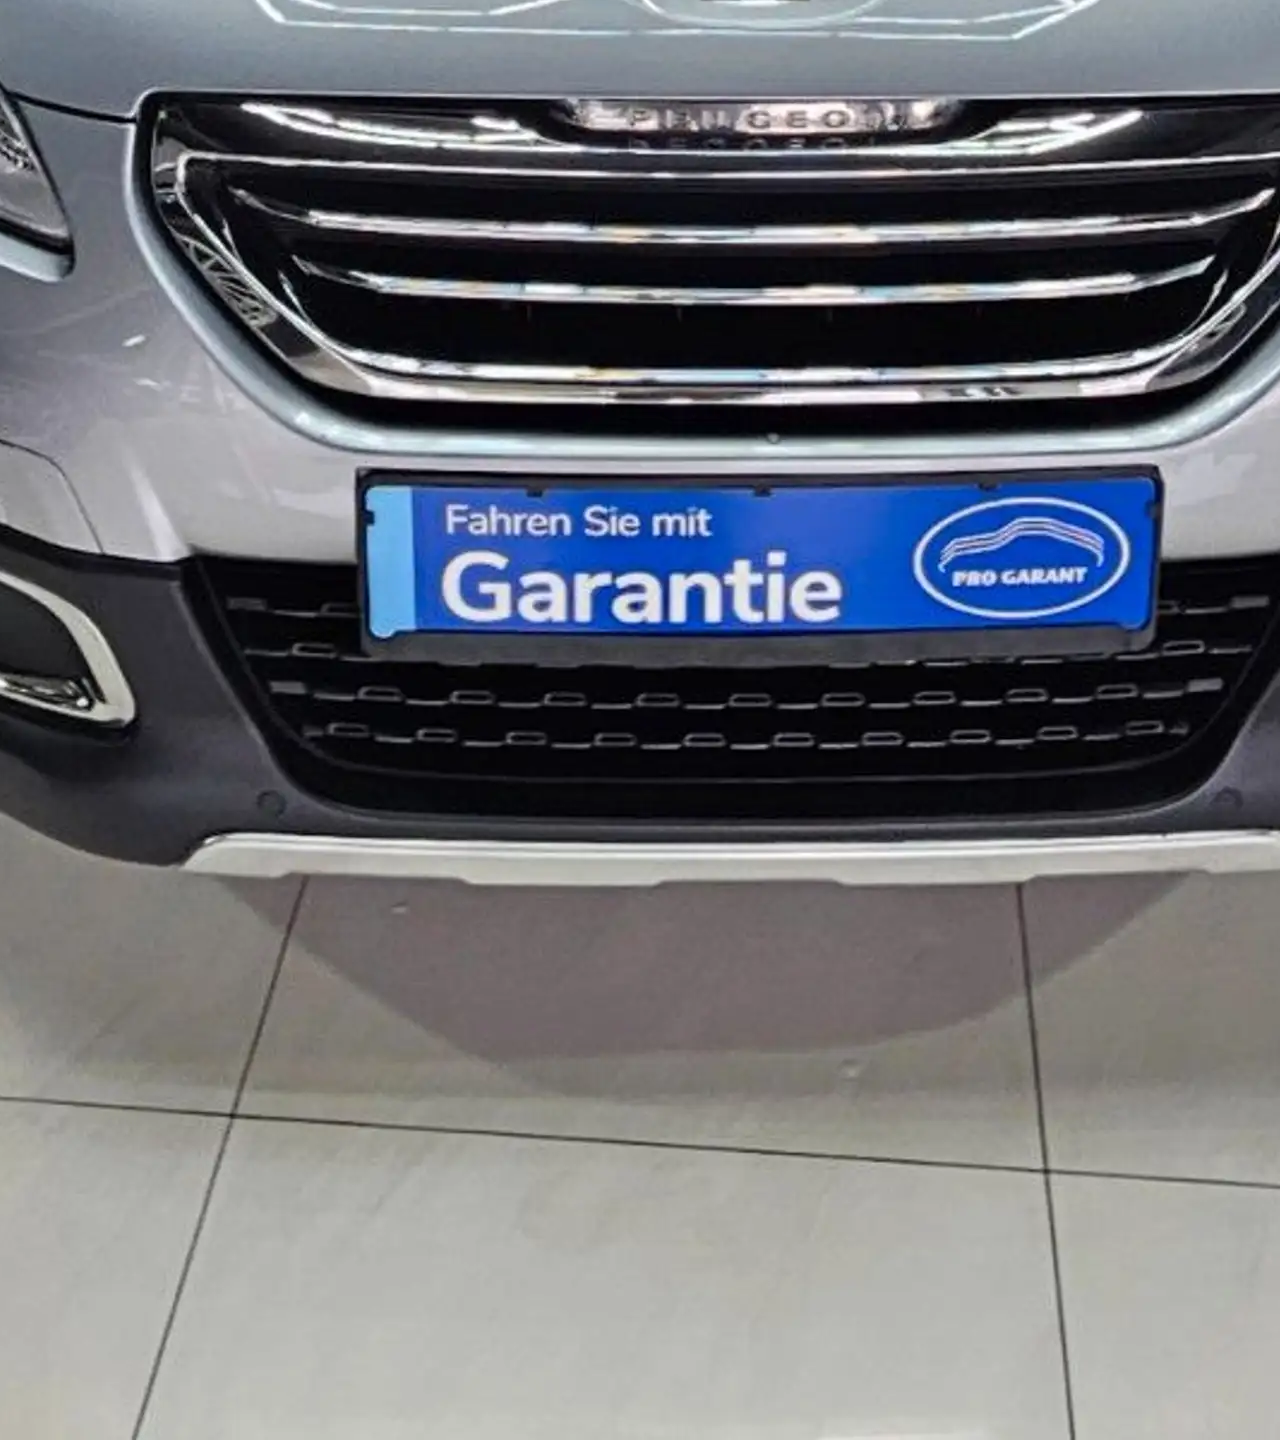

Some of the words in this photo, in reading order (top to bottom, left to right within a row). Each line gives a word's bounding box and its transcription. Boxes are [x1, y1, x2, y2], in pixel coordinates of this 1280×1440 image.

[629, 109, 886, 130] PEUGEO
[445, 503, 572, 536] Fahren
[583, 504, 641, 537] Sie
[651, 506, 713, 538] mit
[441, 549, 843, 624] Garantie
[952, 569, 997, 587] PRO
[1001, 566, 1089, 586] GARANT
